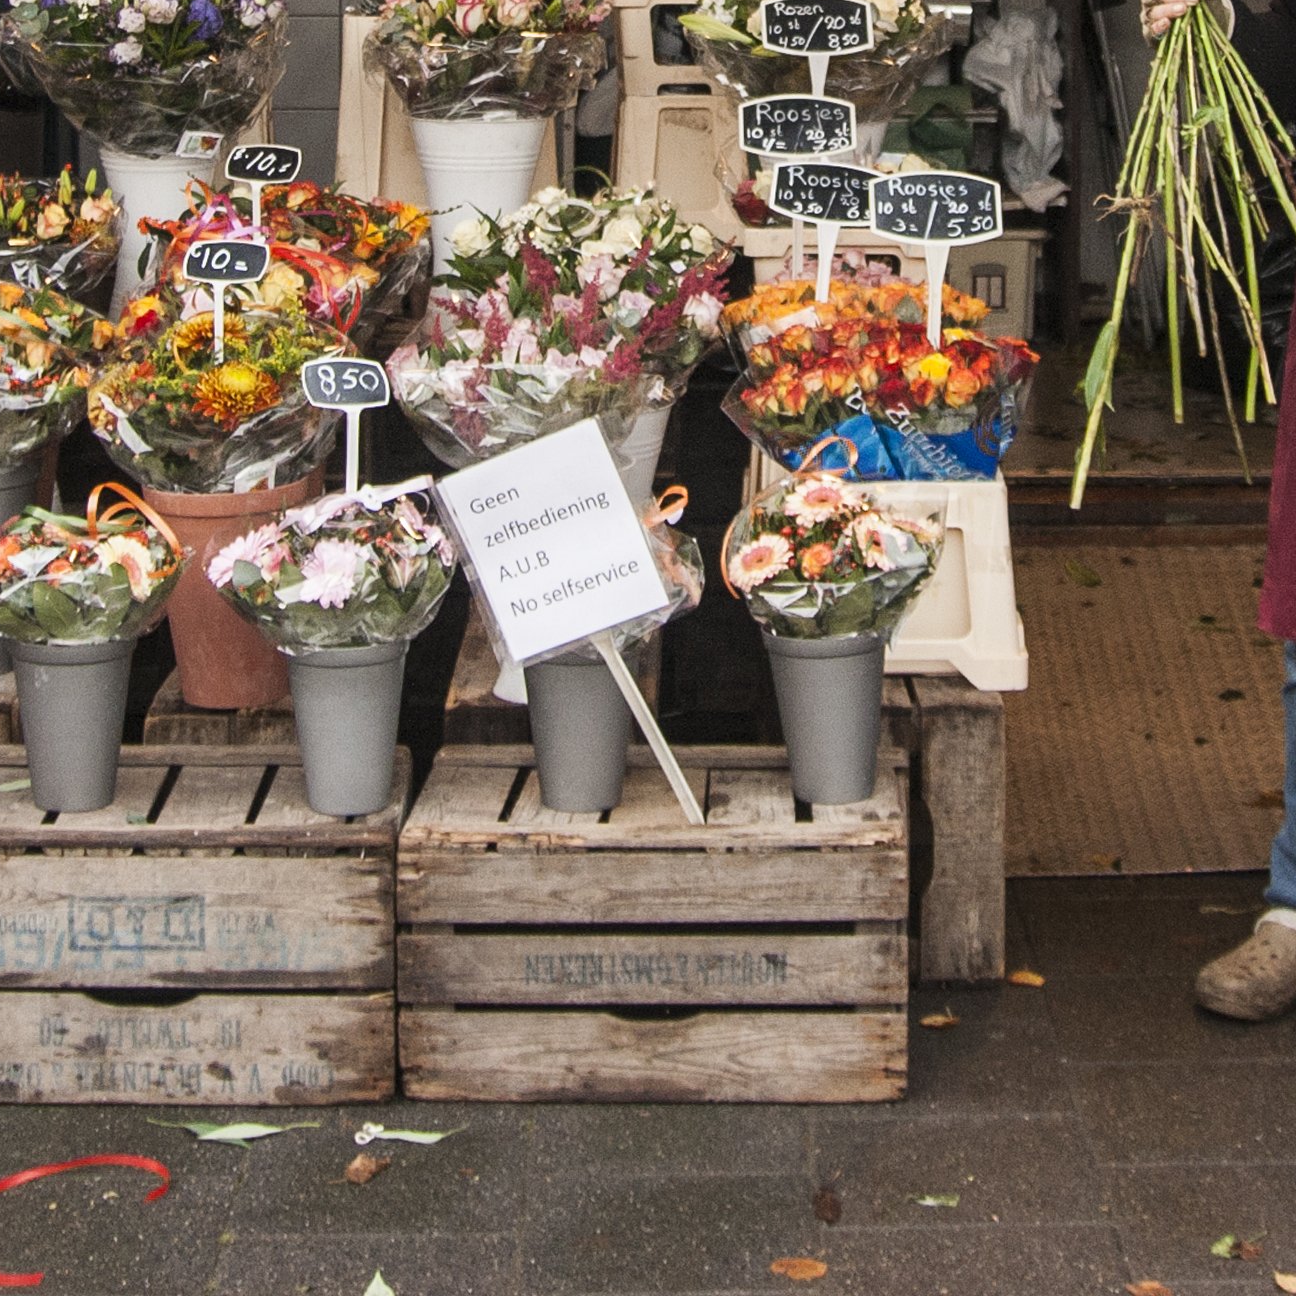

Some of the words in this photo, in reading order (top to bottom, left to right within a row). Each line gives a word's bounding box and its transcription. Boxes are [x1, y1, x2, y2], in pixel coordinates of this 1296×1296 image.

[774, 2, 824, 16] Rozen
[768, 25, 782, 35] 10
[824, 16, 845, 30] 20
[755, 104, 845, 131] Roosjes
[747, 127, 763, 140] 10
[806, 129, 824, 140] 20
[778, 189, 793, 200] 10
[788, 166, 870, 197] Roosjes
[889, 178, 968, 204] Roosjes
[877, 203, 894, 215] 10
[949, 203, 969, 215] 20
[469, 486, 520, 515] Geen
[484, 491, 610, 549] zelfbediening
[498, 550, 551, 582] A.U.B
[509, 597, 539, 617] No
[542, 558, 641, 606] selfservice
